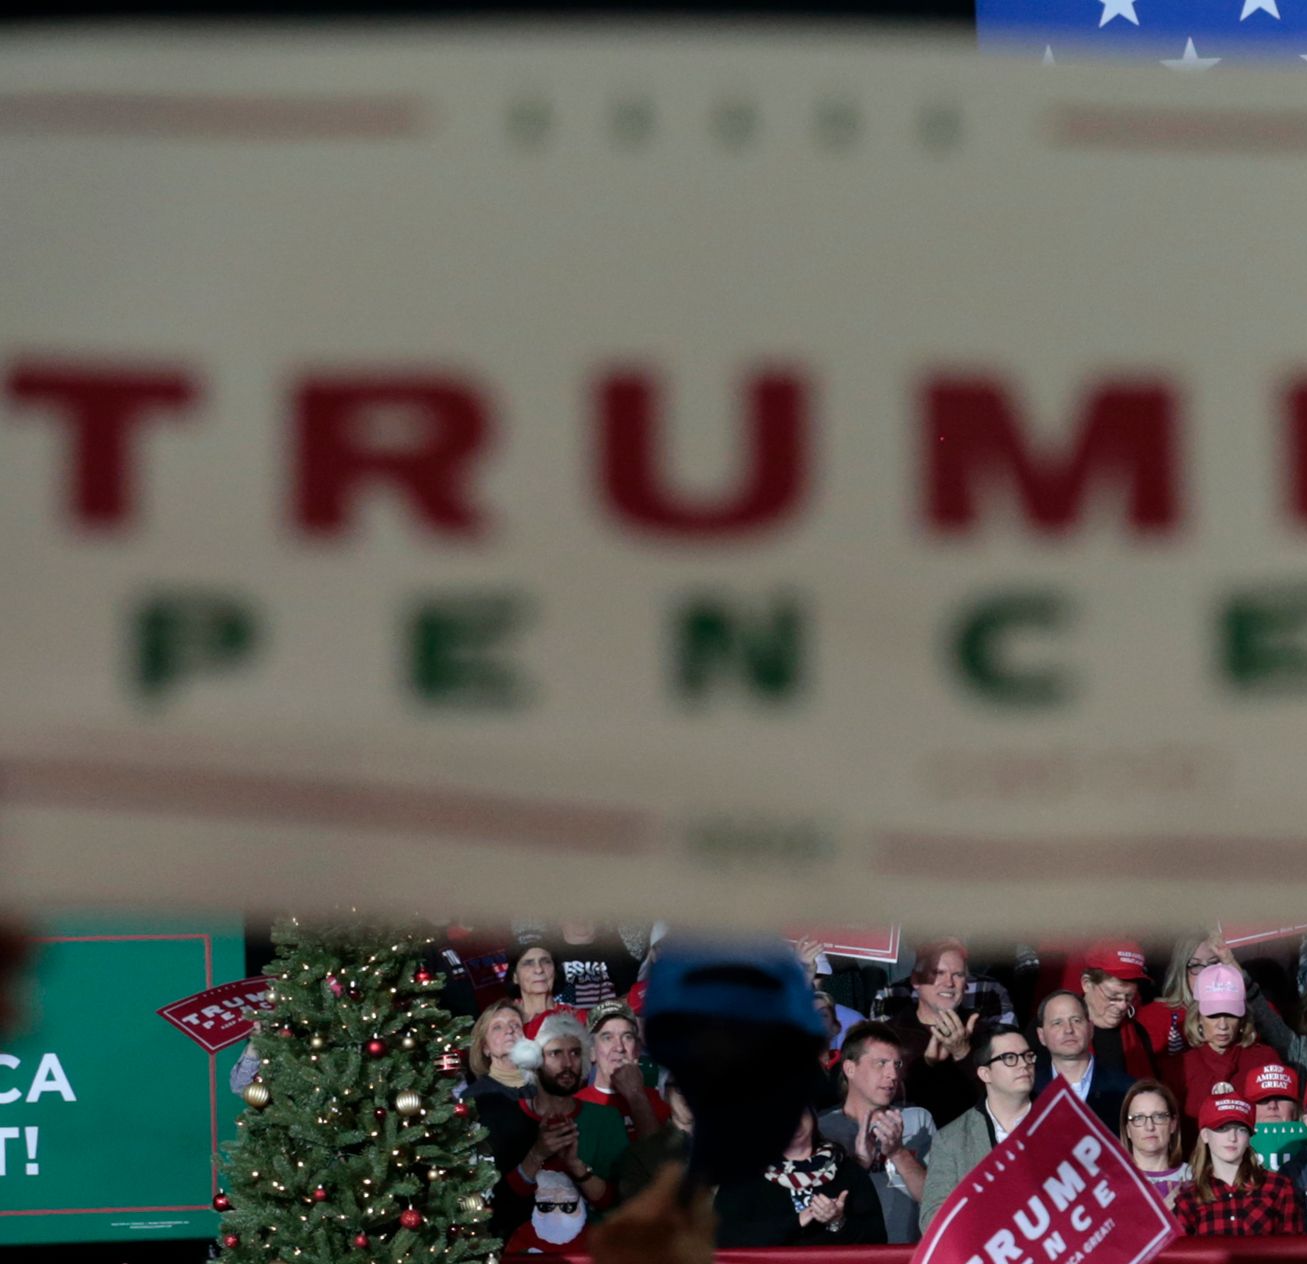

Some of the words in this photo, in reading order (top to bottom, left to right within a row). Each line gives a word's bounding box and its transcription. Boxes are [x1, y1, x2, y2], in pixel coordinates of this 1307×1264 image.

[1263, 1065, 1285, 1073] KEEP
[1256, 1073, 1292, 1084] AMERICA
[1261, 1081, 1289, 1090] GREAT
[1084, 1218, 1116, 1254] GREAT!
